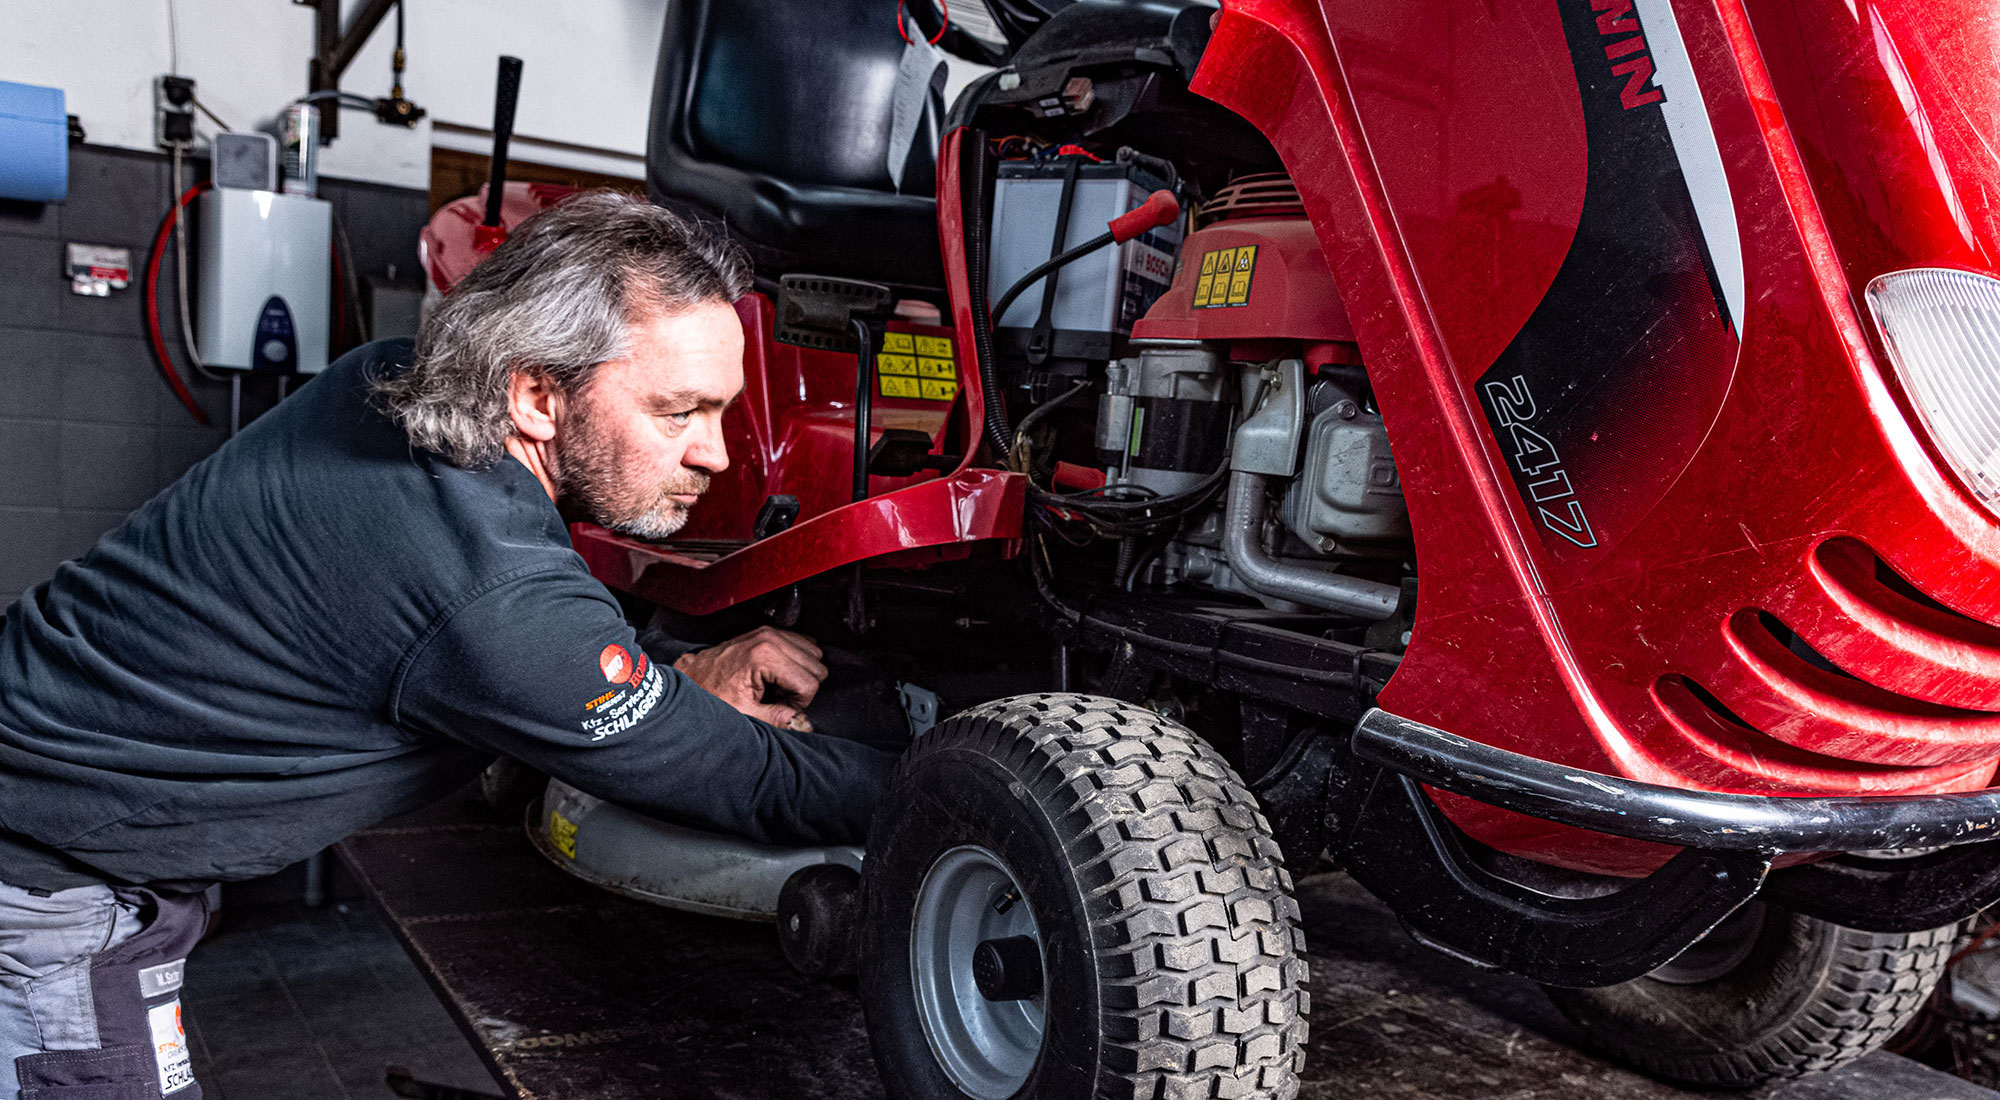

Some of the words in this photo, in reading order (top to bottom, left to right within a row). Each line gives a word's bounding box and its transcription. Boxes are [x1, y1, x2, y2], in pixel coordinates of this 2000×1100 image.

[1146, 253, 1171, 279] BOSCH
[1485, 375, 1598, 547] 2417
[609, 689, 645, 719] Service
